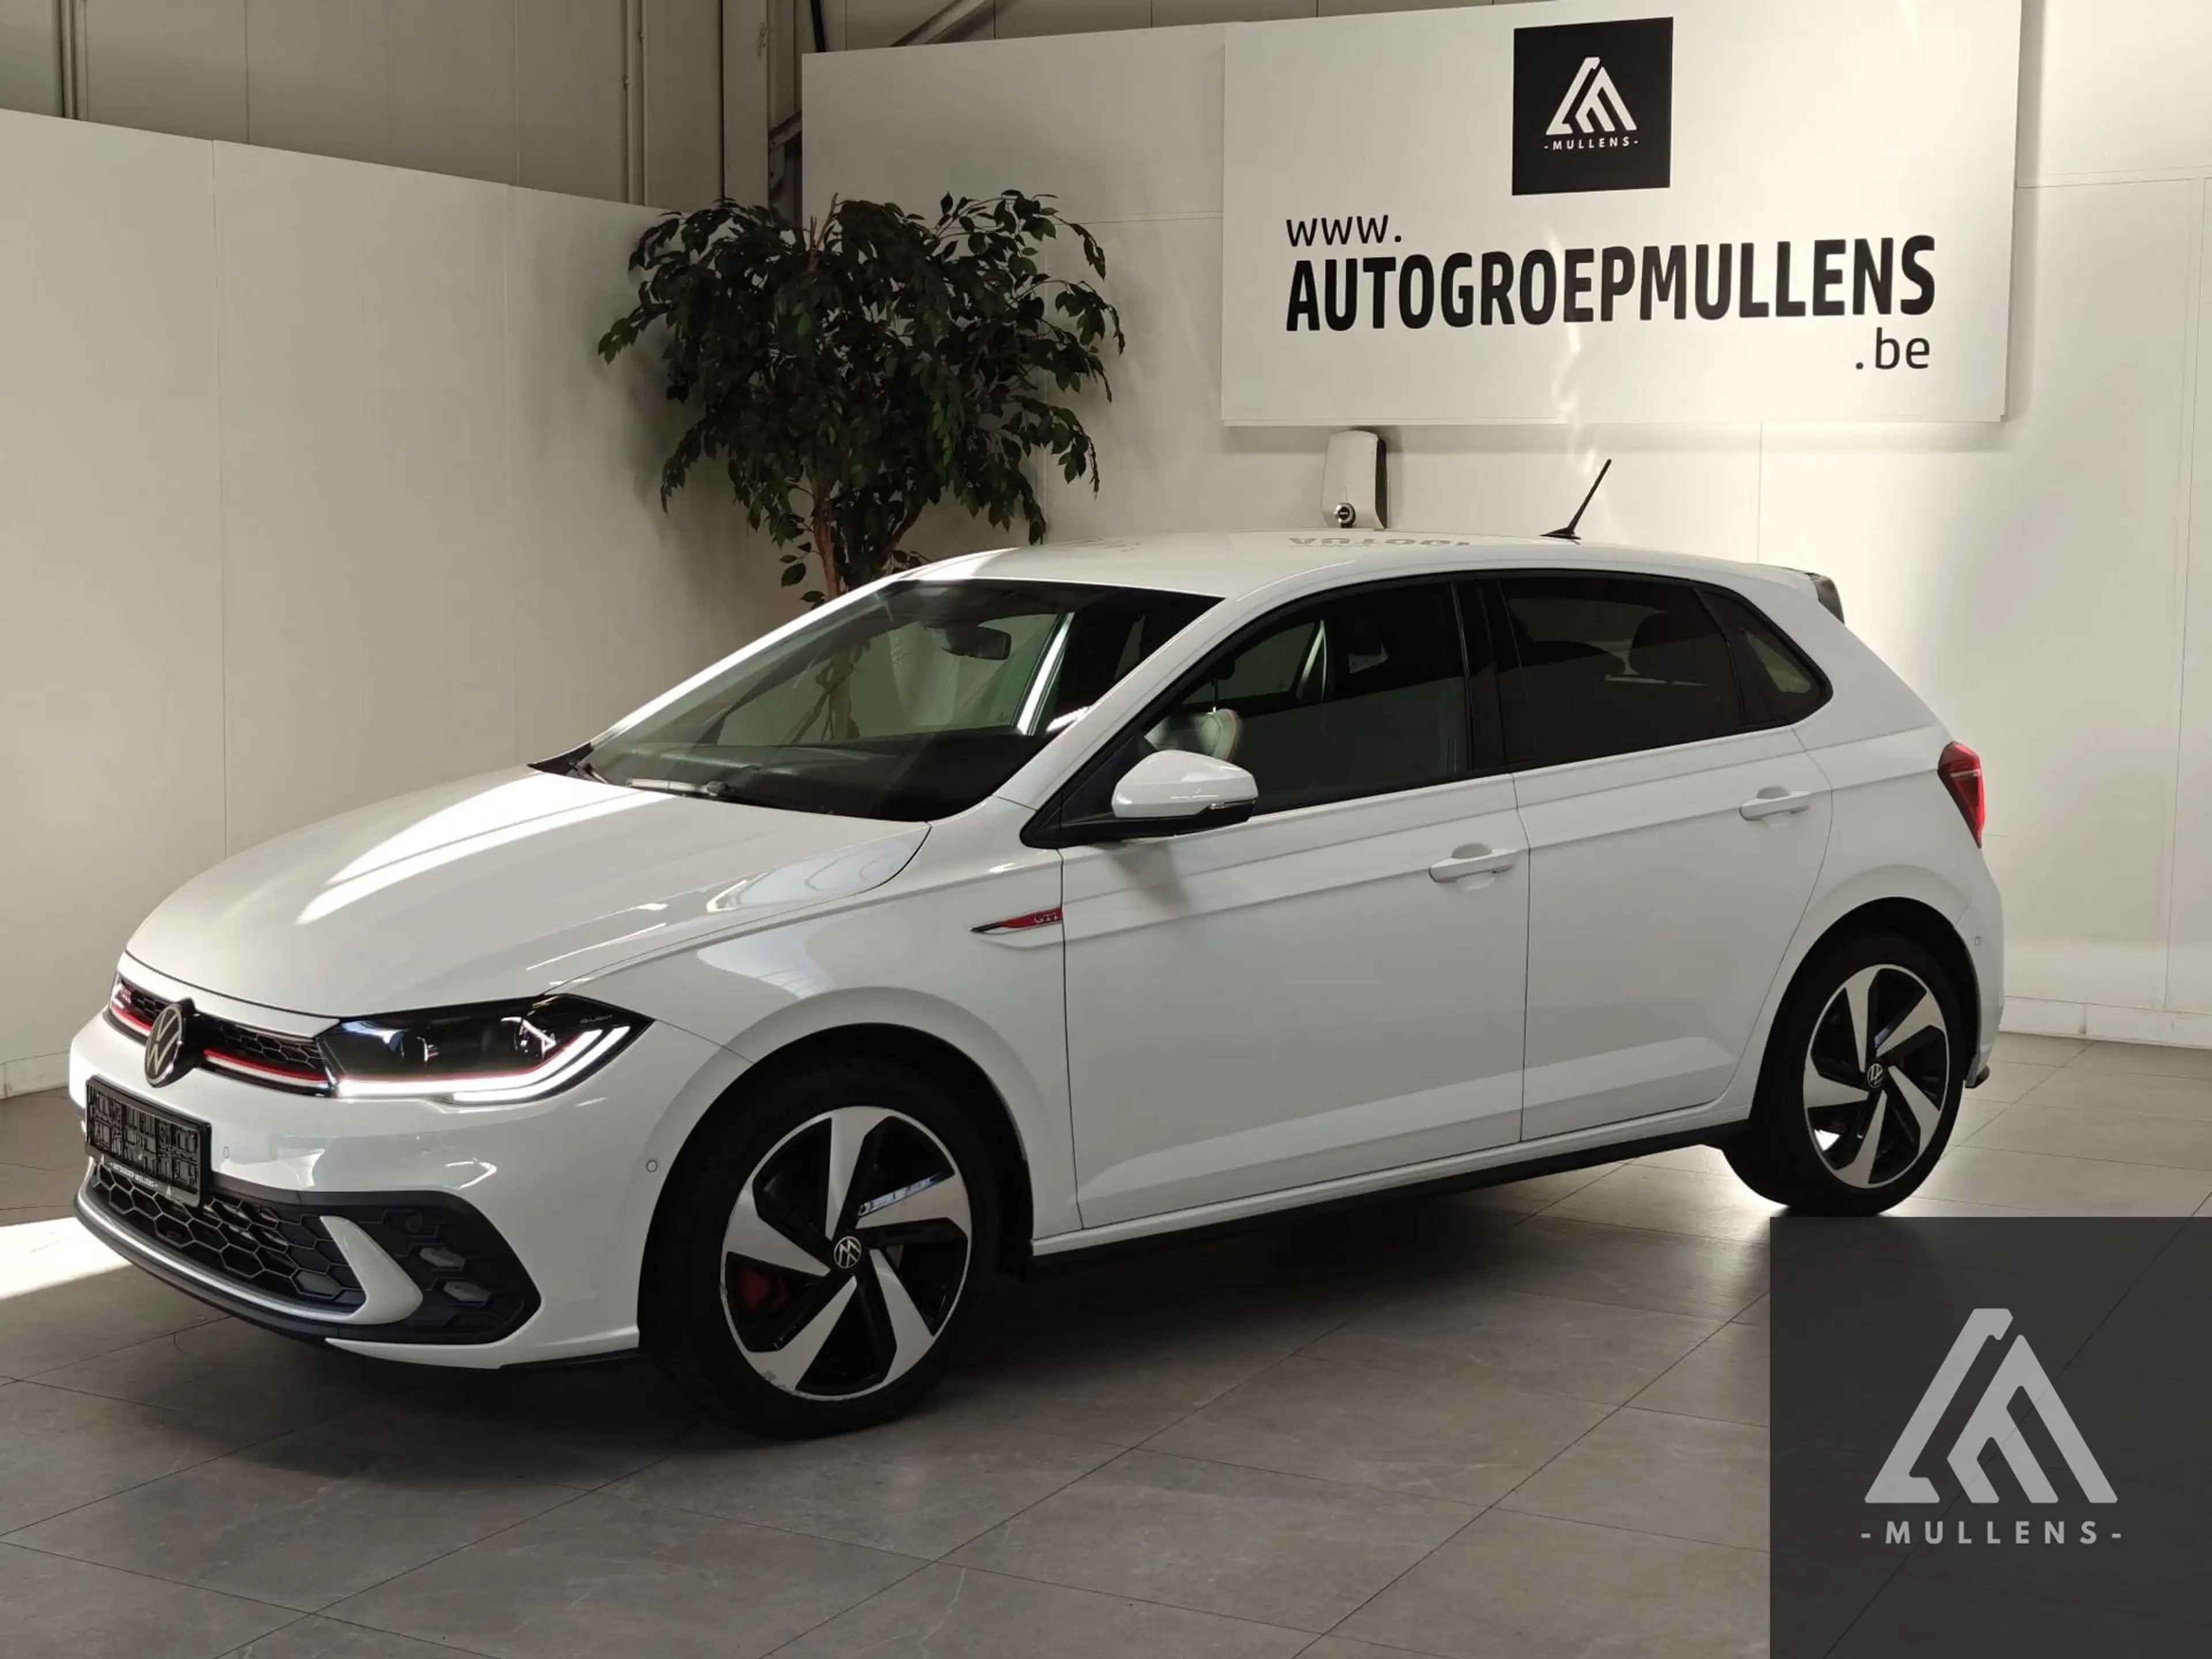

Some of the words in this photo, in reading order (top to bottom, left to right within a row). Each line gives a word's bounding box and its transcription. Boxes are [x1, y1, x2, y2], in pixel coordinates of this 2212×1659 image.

[1285, 214, 1403, 248] www.
[1286, 234, 1936, 332] AUTOGROEPMULLENS
[1855, 326, 1930, 370] .be
